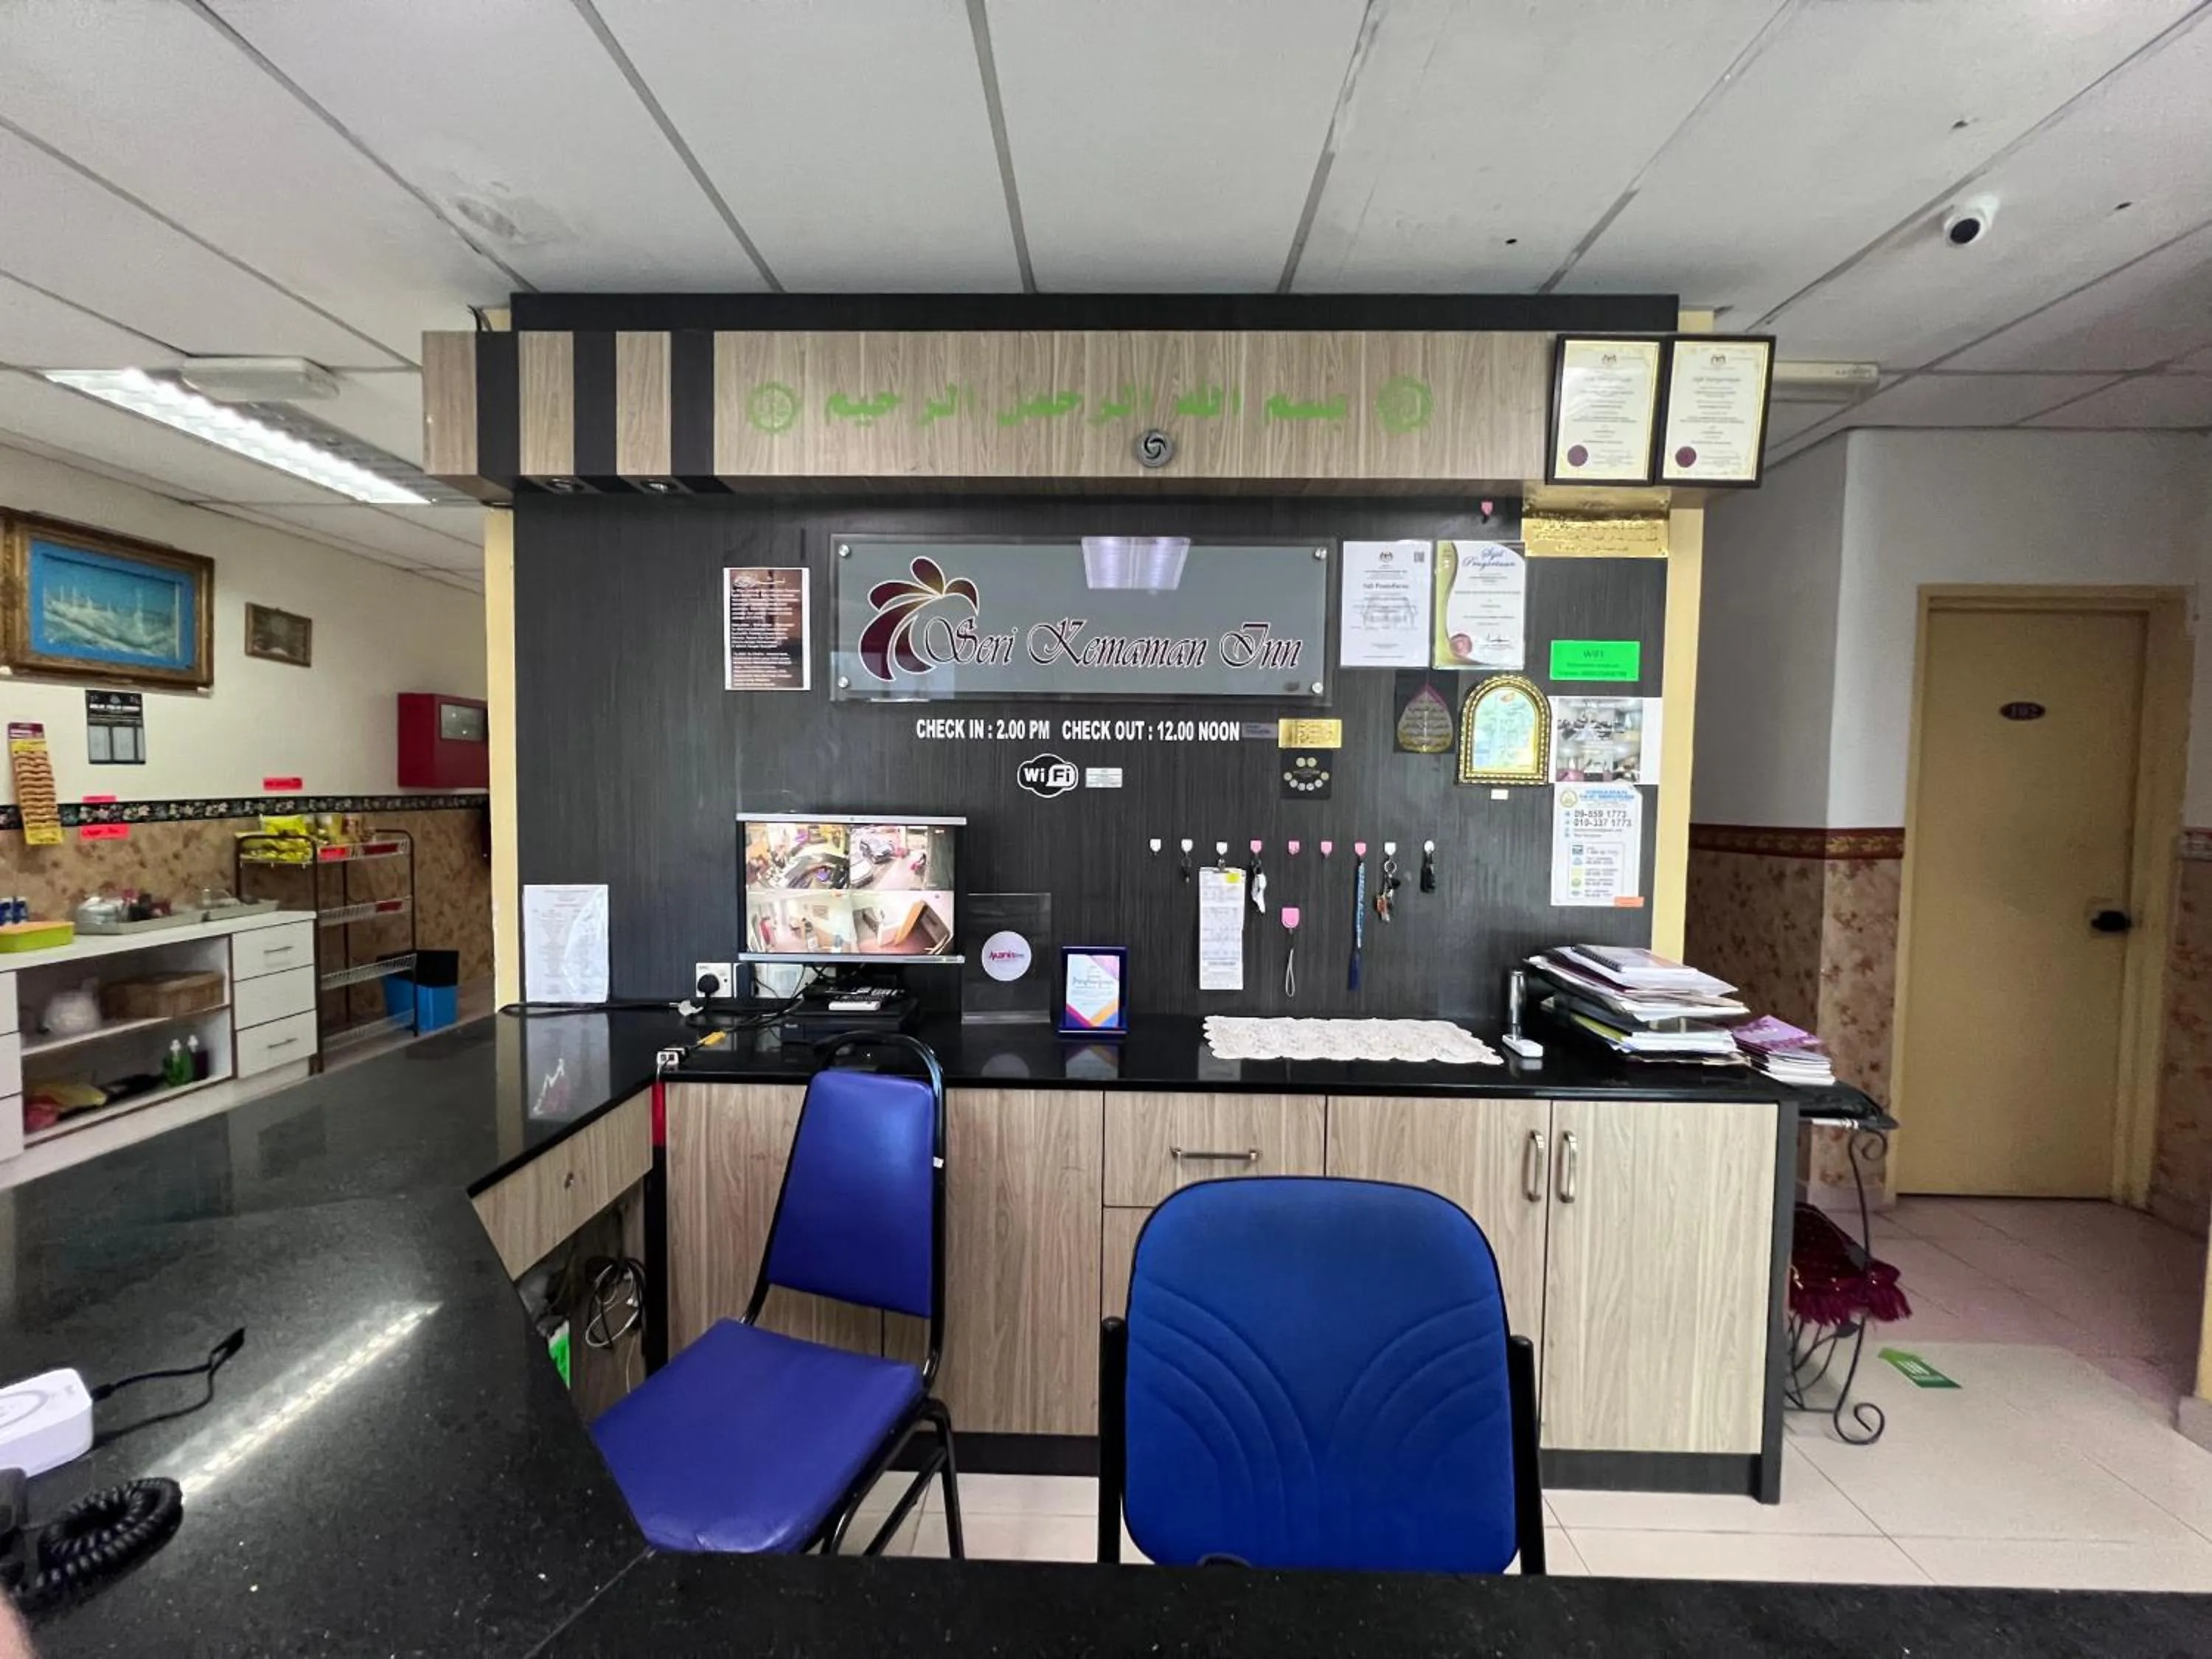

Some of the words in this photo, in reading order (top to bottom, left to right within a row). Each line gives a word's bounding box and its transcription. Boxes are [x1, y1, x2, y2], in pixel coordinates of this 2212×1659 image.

[924, 616, 1018, 665] Seri
[1026, 617, 1208, 668] Kemaman
[1220, 622, 1304, 669] Inn
[916, 719, 965, 739] CHECK
[969, 719, 984, 740] IN
[996, 719, 1026, 740] 2.00
[1029, 720, 1050, 740] PM
[1062, 720, 1111, 740] CHECK
[1115, 720, 1145, 741] OUT
[1157, 720, 1194, 741] 12.00
[1198, 720, 1240, 741] NOON
